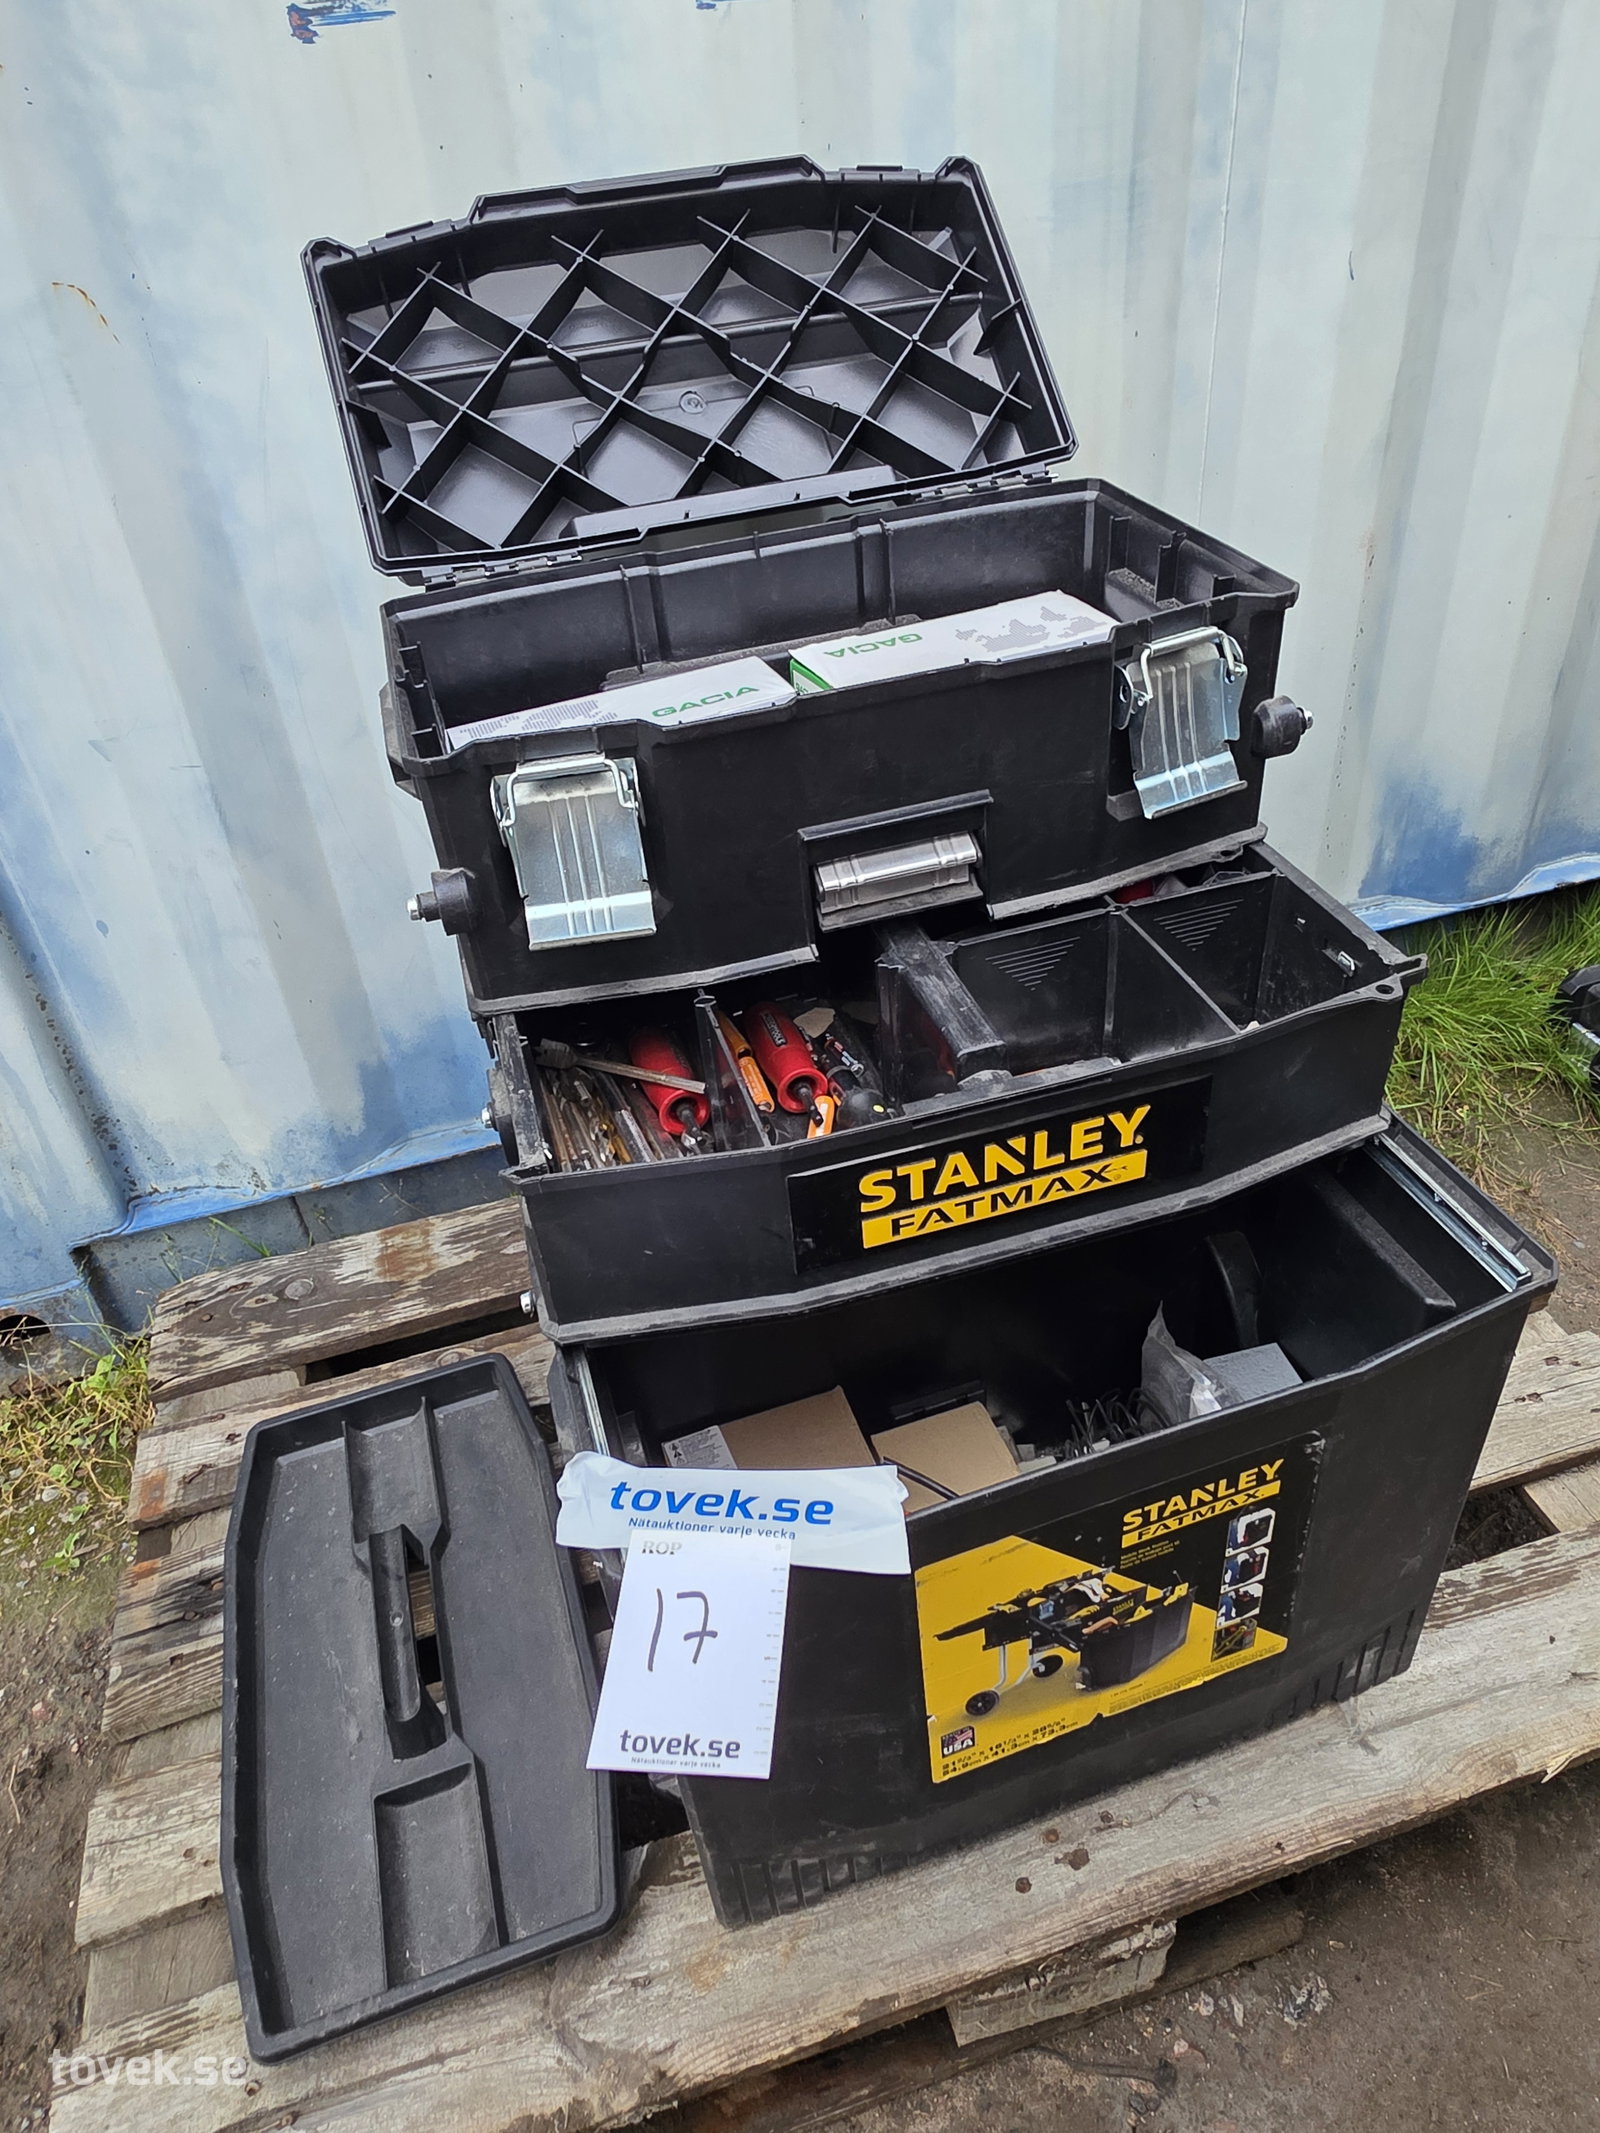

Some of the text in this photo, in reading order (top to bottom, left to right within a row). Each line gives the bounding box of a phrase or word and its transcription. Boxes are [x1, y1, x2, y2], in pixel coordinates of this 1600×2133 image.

[823, 633, 923, 658] GACIA
[652, 687, 760, 717] GACIA
[858, 1104, 1151, 1213] STANLEY
[891, 1162, 1122, 1239] FATMAX
[610, 1481, 834, 1525] tovek.se
[1122, 1458, 1284, 1532] STANLEY
[719, 1525, 753, 1538] varje
[757, 1527, 796, 1541] vecka
[1137, 1488, 1261, 1541] FATMAX
[641, 1540, 683, 1556] ROP
[647, 1588, 718, 1672] 17
[619, 1730, 741, 1759] tovek.se
[943, 1738, 974, 1755] USA
